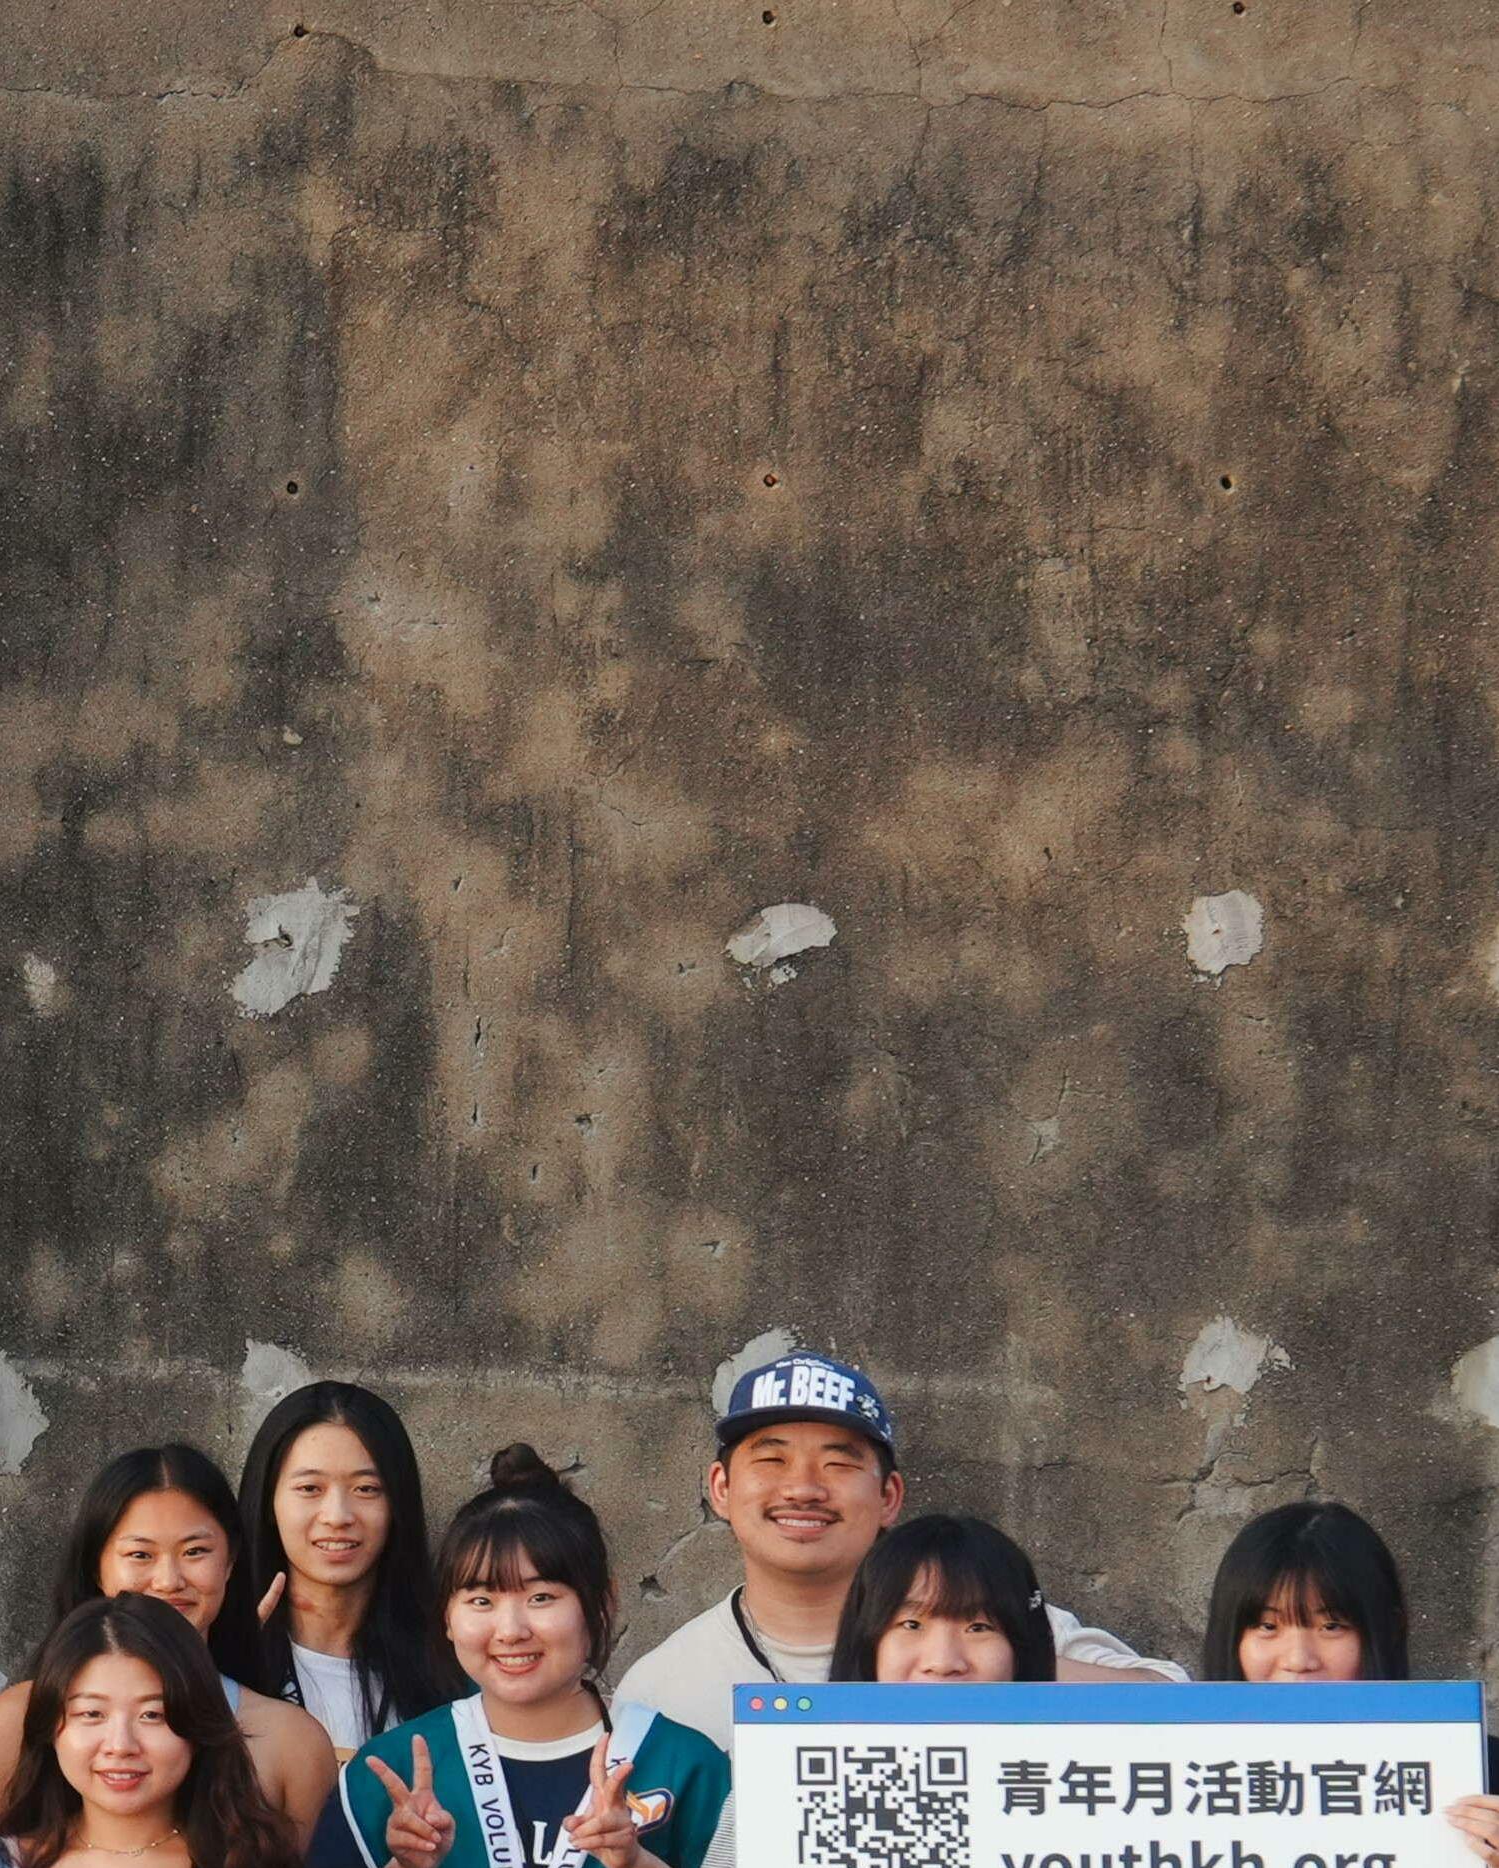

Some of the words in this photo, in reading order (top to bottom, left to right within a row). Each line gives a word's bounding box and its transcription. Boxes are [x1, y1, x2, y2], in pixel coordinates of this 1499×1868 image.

[751, 1370, 787, 1409] Mr.
[789, 1365, 856, 1412] BEEF
[468, 1743, 495, 1787] KYB
[996, 1759, 1434, 1817] 青年月活動官網
